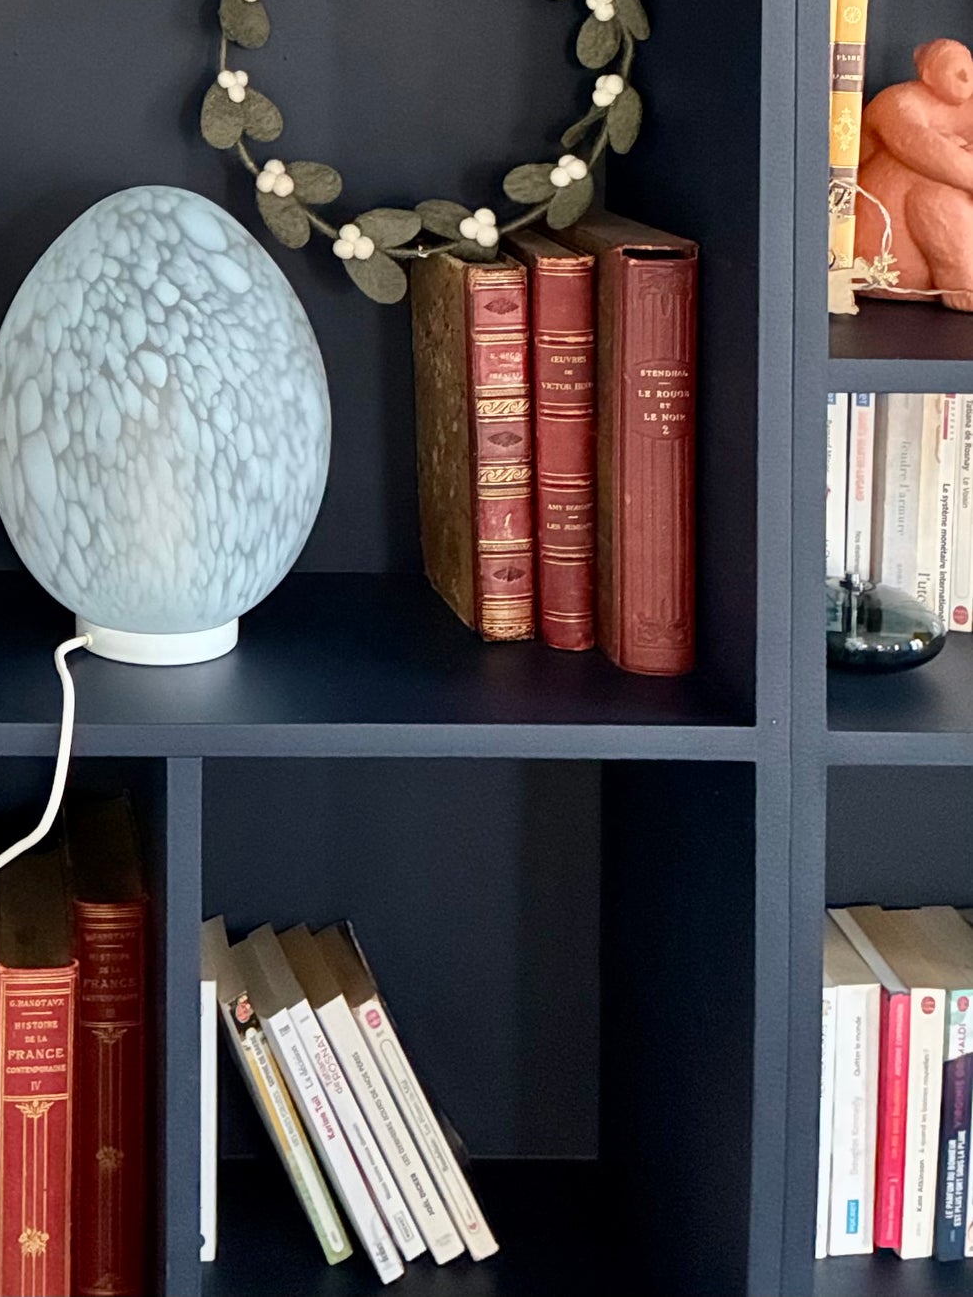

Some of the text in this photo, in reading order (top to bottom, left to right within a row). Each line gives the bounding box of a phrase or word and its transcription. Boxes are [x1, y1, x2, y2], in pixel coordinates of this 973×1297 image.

[640, 369, 689, 377] STENDHAL
[540, 382, 572, 391] VICTOR
[638, 389, 651, 398] LE
[643, 412, 658, 421] LE
[661, 424, 671, 435] 2
[963, 429, 972, 441] de
[962, 442, 972, 471] Rosnay
[962, 477, 970, 509] Le Voisin
[937, 483, 951, 621] Le système monétaire international
[14, 1020, 59, 1030] HISTOIRE
[854, 1016, 863, 1042] monde
[24, 1034, 48, 1043] DE LA
[7, 1047, 65, 1061] FRANCE
[311, 1032, 343, 1081] ROSNAY
[285, 1044, 314, 1089] La décision
[854, 1050, 863, 1077] Quitter
[30, 1080, 42, 1092] IV
[308, 1094, 337, 1140] Karine Tuil
[956, 1150, 965, 1159] LA
[946, 1171, 955, 1181] DU
[408, 1172, 427, 1199] DICKER
[916, 1159, 926, 1212] Kate Atkinson
[955, 1177, 964, 1195] FORT
[945, 1182, 955, 1210] PARFUM
[954, 1195, 963, 1213] PLUS
[945, 1210, 953, 1219] LE
[953, 1213, 962, 1227] EST
